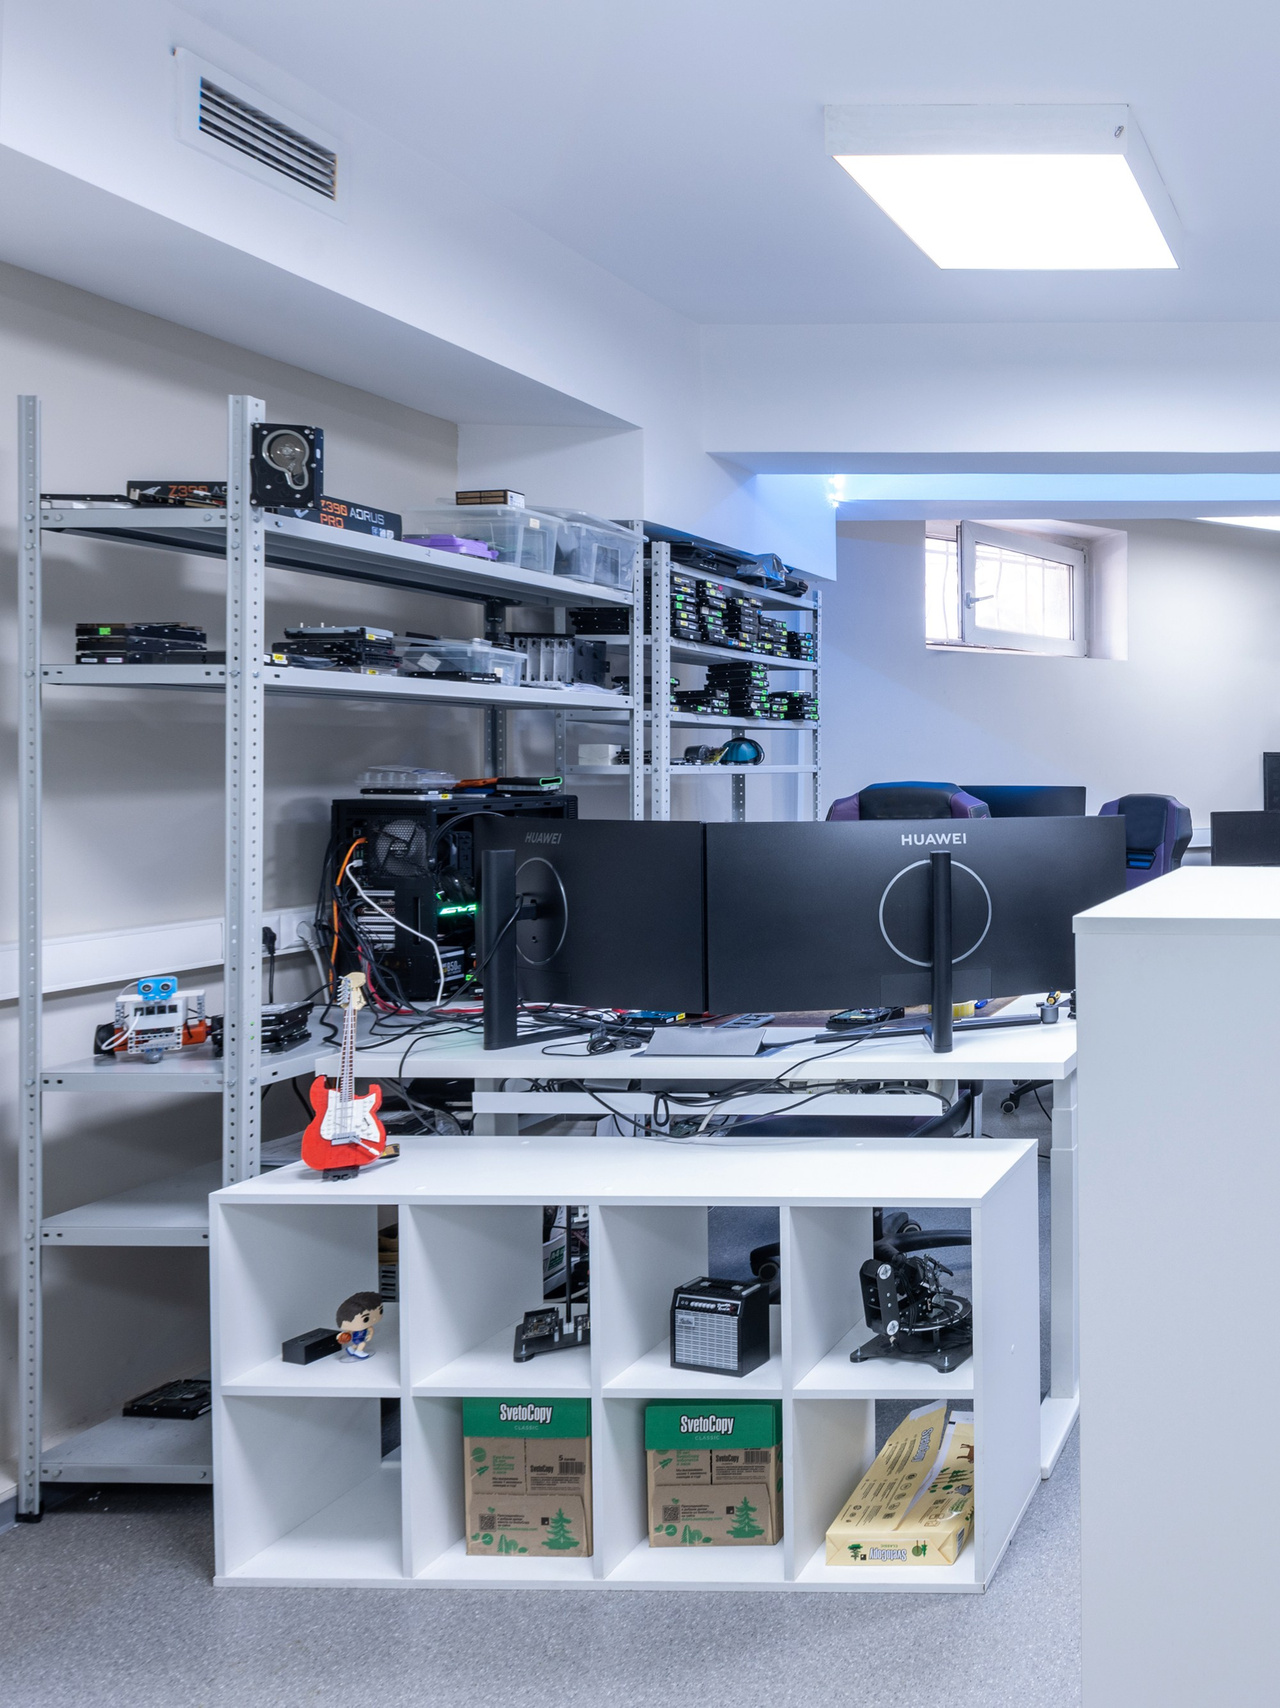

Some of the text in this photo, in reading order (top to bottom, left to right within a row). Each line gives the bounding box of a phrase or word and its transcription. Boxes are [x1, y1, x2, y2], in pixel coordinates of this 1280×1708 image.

[319, 513, 344, 529] PRO
[349, 507, 385, 525] AORUS
[524, 832, 562, 845] HUAWEI
[900, 832, 967, 846] HUAWEI
[500, 1403, 553, 1424] SvetoCopy
[680, 1414, 735, 1435] SvetoCopy
[868, 1547, 907, 1562] SvetoCopy
